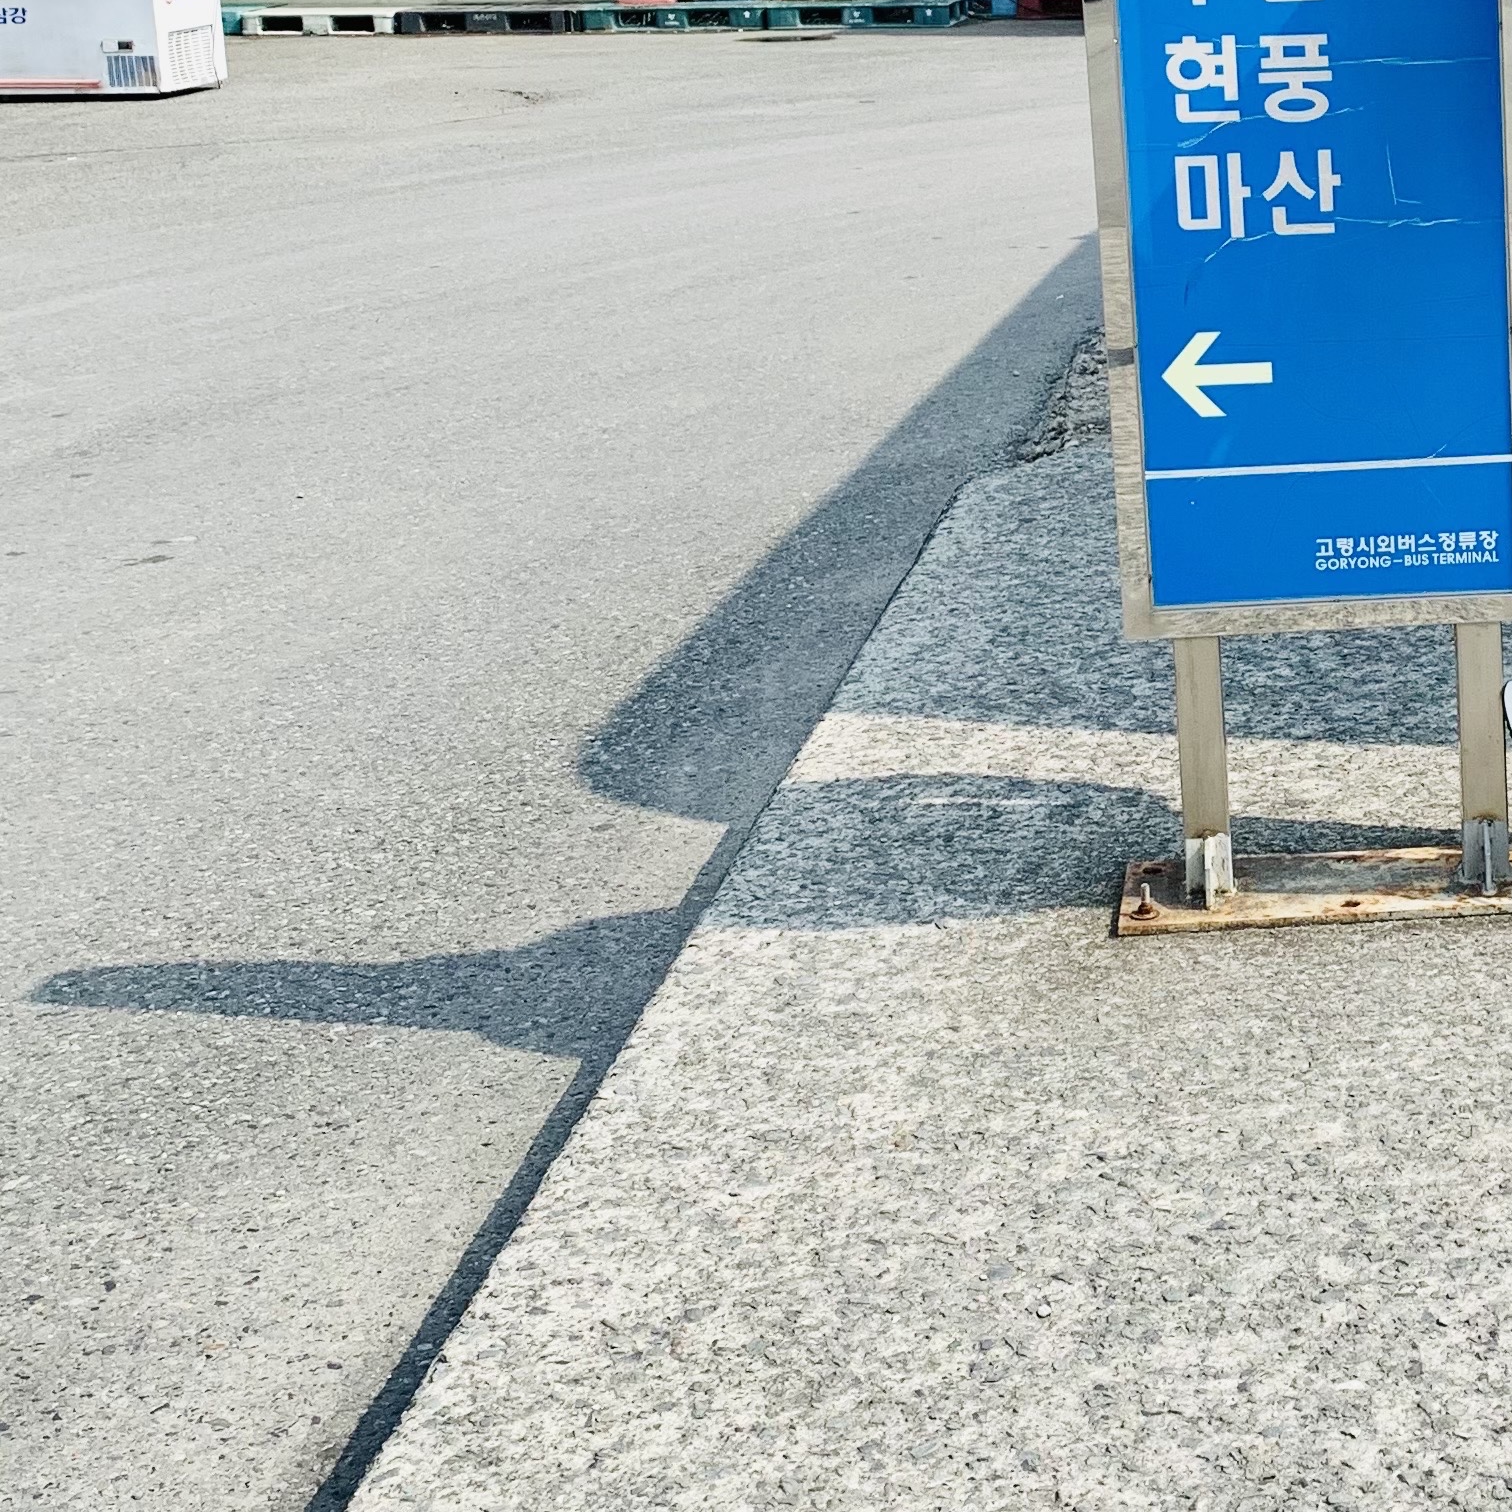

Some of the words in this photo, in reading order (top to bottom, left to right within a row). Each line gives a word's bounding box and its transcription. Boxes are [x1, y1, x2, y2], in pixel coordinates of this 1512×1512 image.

[1164, 33, 1333, 123] 현풍
[1174, 149, 1342, 238] 마산
[1315, 530, 1500, 557] 고령시외버스정류장
[1433, 550, 1500, 566] TERMINAL
